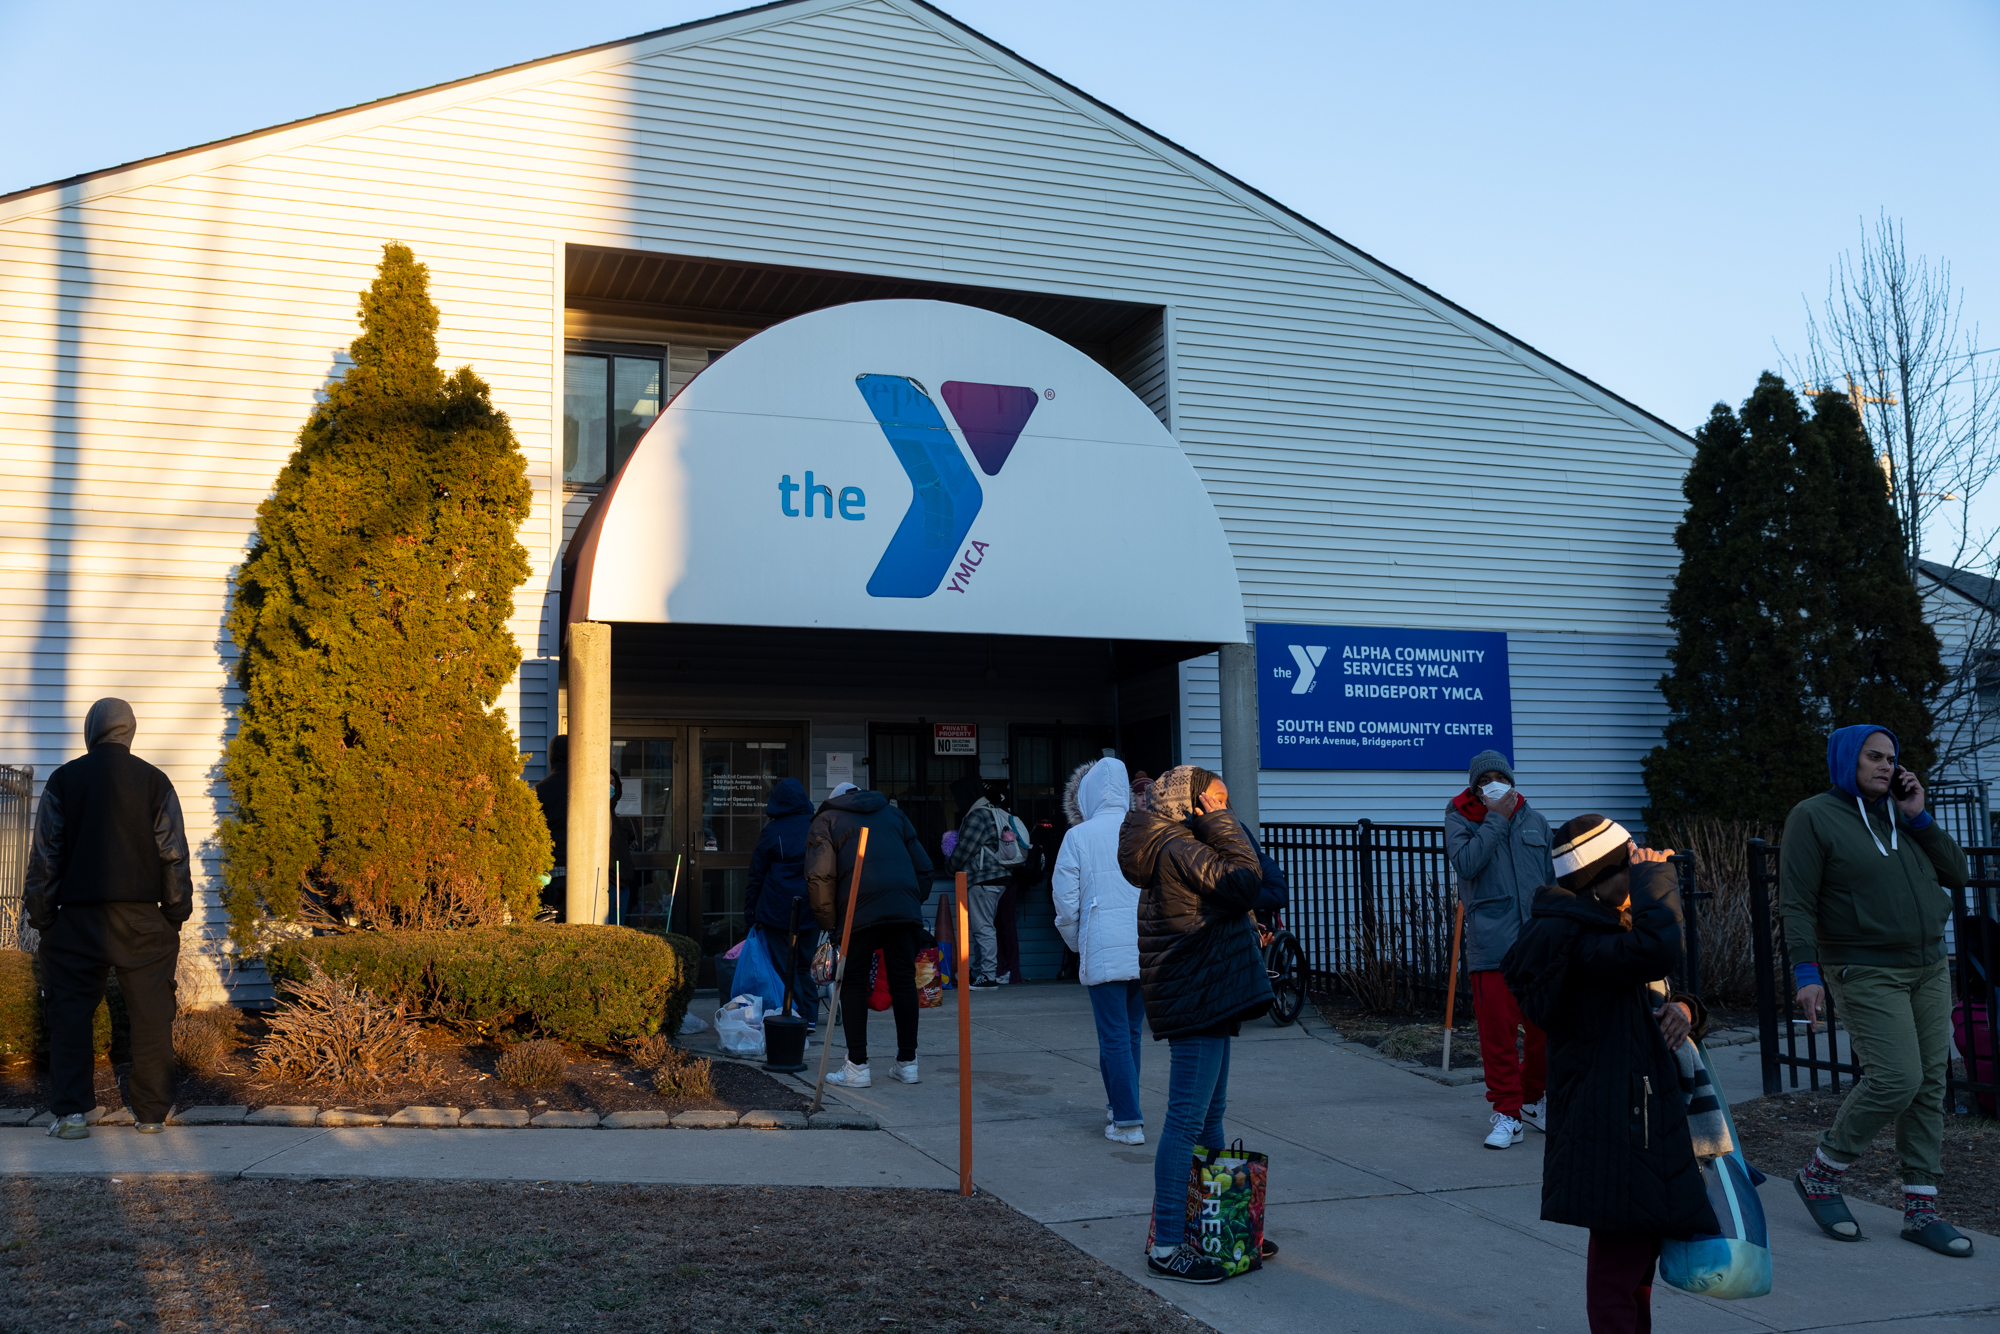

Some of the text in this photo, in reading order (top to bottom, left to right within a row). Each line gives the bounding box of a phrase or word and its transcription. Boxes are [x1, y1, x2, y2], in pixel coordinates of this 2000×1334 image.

[778, 471, 866, 521] the
[947, 540, 990, 594] YMCA
[1343, 645, 1485, 663] ALPHA COMMUNITY
[1273, 667, 1292, 678] the
[1344, 661, 1459, 678] SERVICES YMCA
[1308, 680, 1317, 693] YMCA
[1345, 684, 1484, 700] BRIDGEPORT YMCA
[1277, 719, 1494, 735] SOUTH END COMMUNITY CENTER
[937, 739, 951, 752] NO
[1277, 735, 1425, 748] 650 Park Avenue, Bridgeport CT
